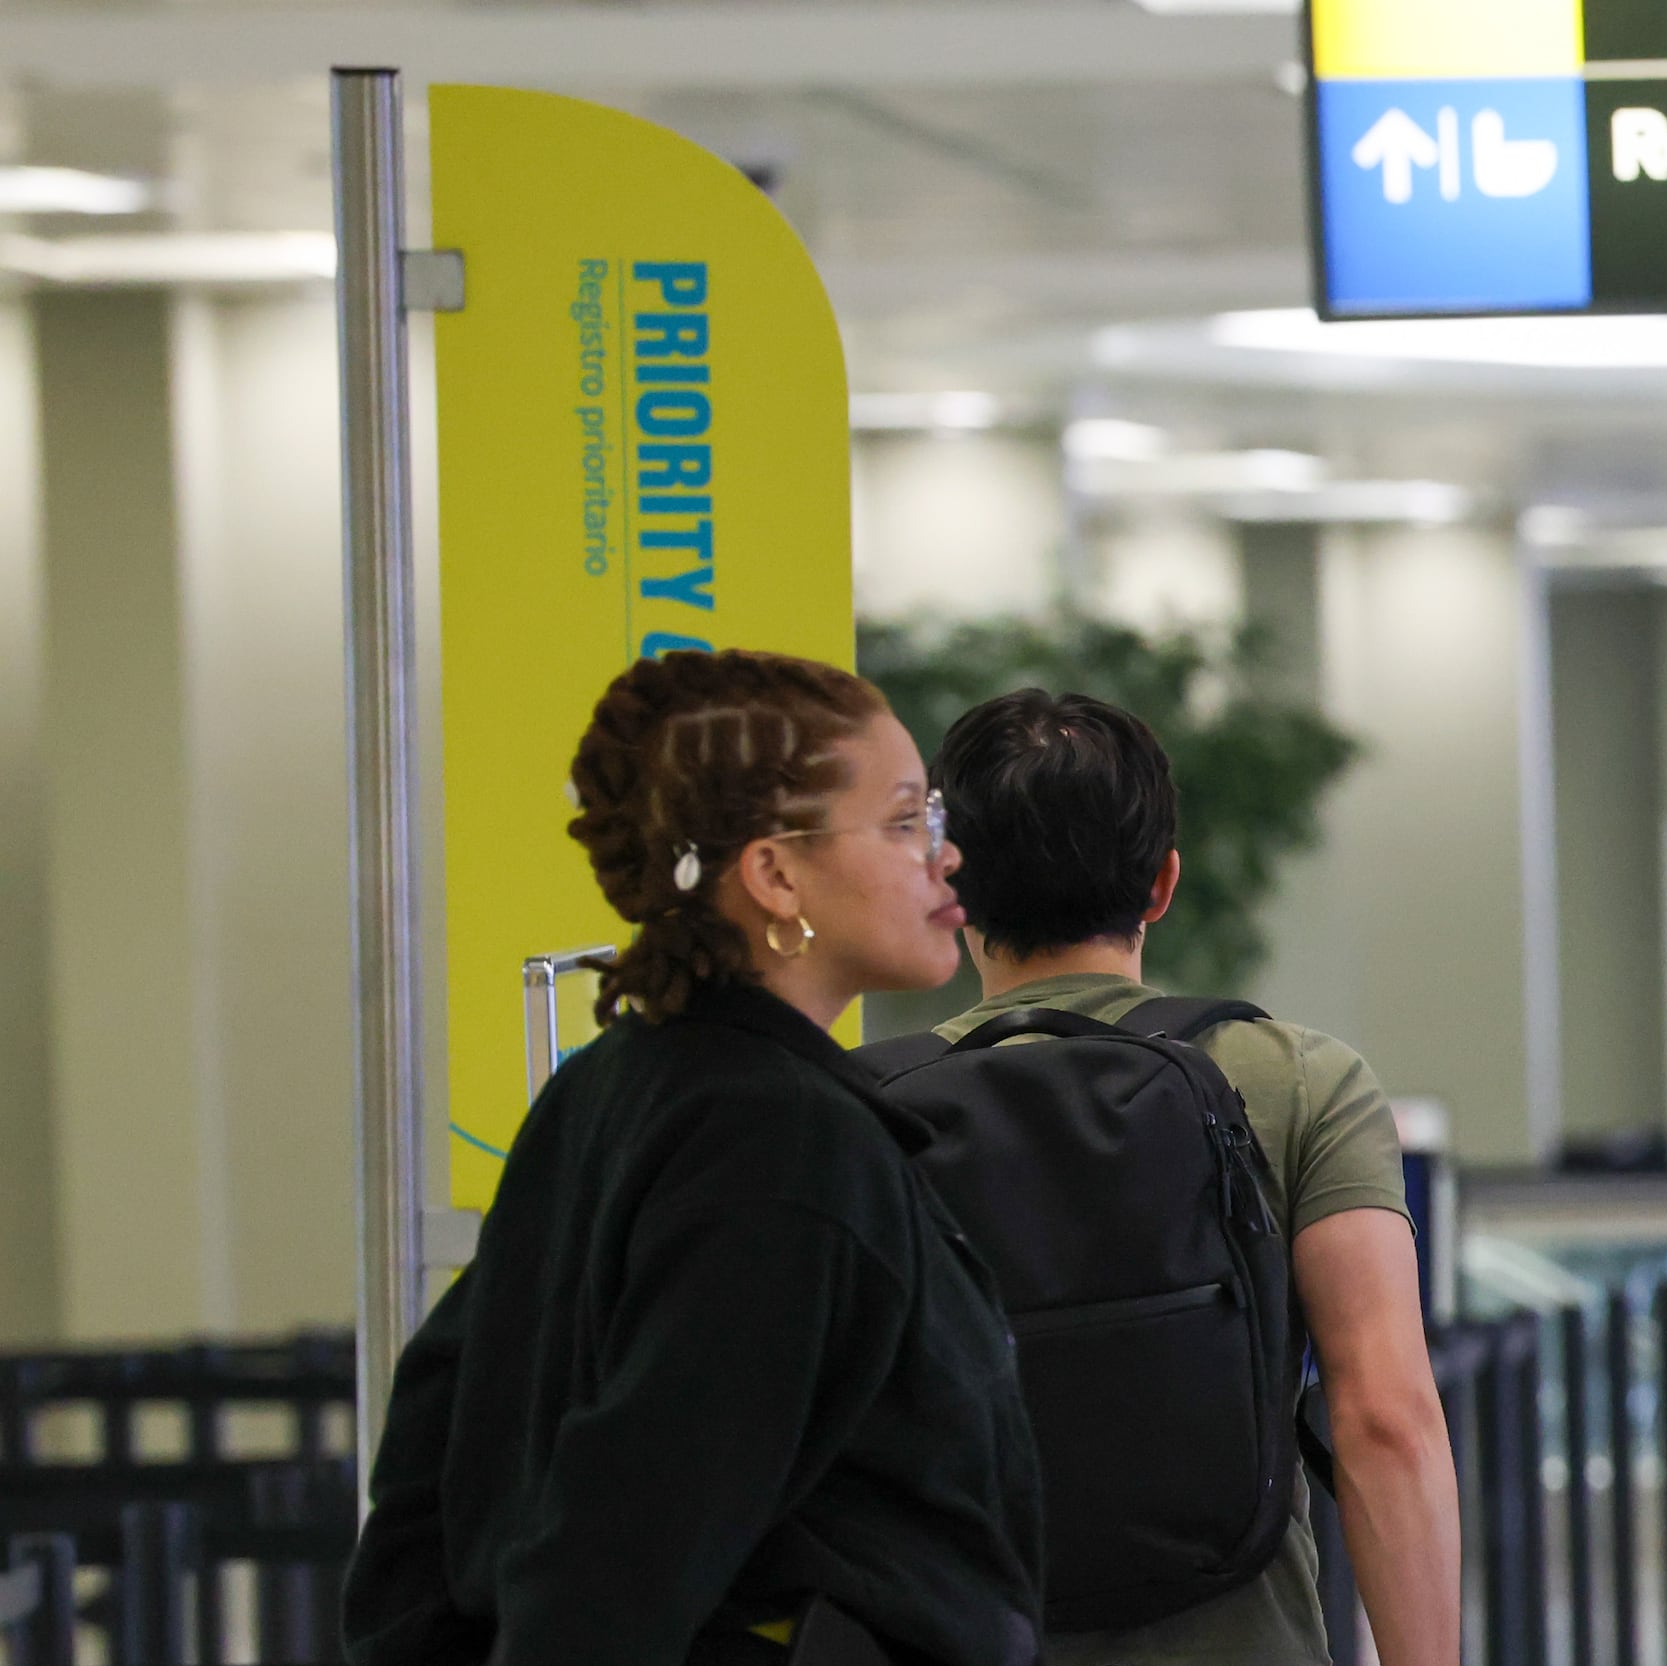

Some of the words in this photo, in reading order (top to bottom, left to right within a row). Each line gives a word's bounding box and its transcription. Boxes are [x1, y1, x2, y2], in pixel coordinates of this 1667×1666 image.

[570, 258, 611, 397] Registro
[574, 405, 616, 576] prioritario
[633, 262, 716, 612] PRIORITY
